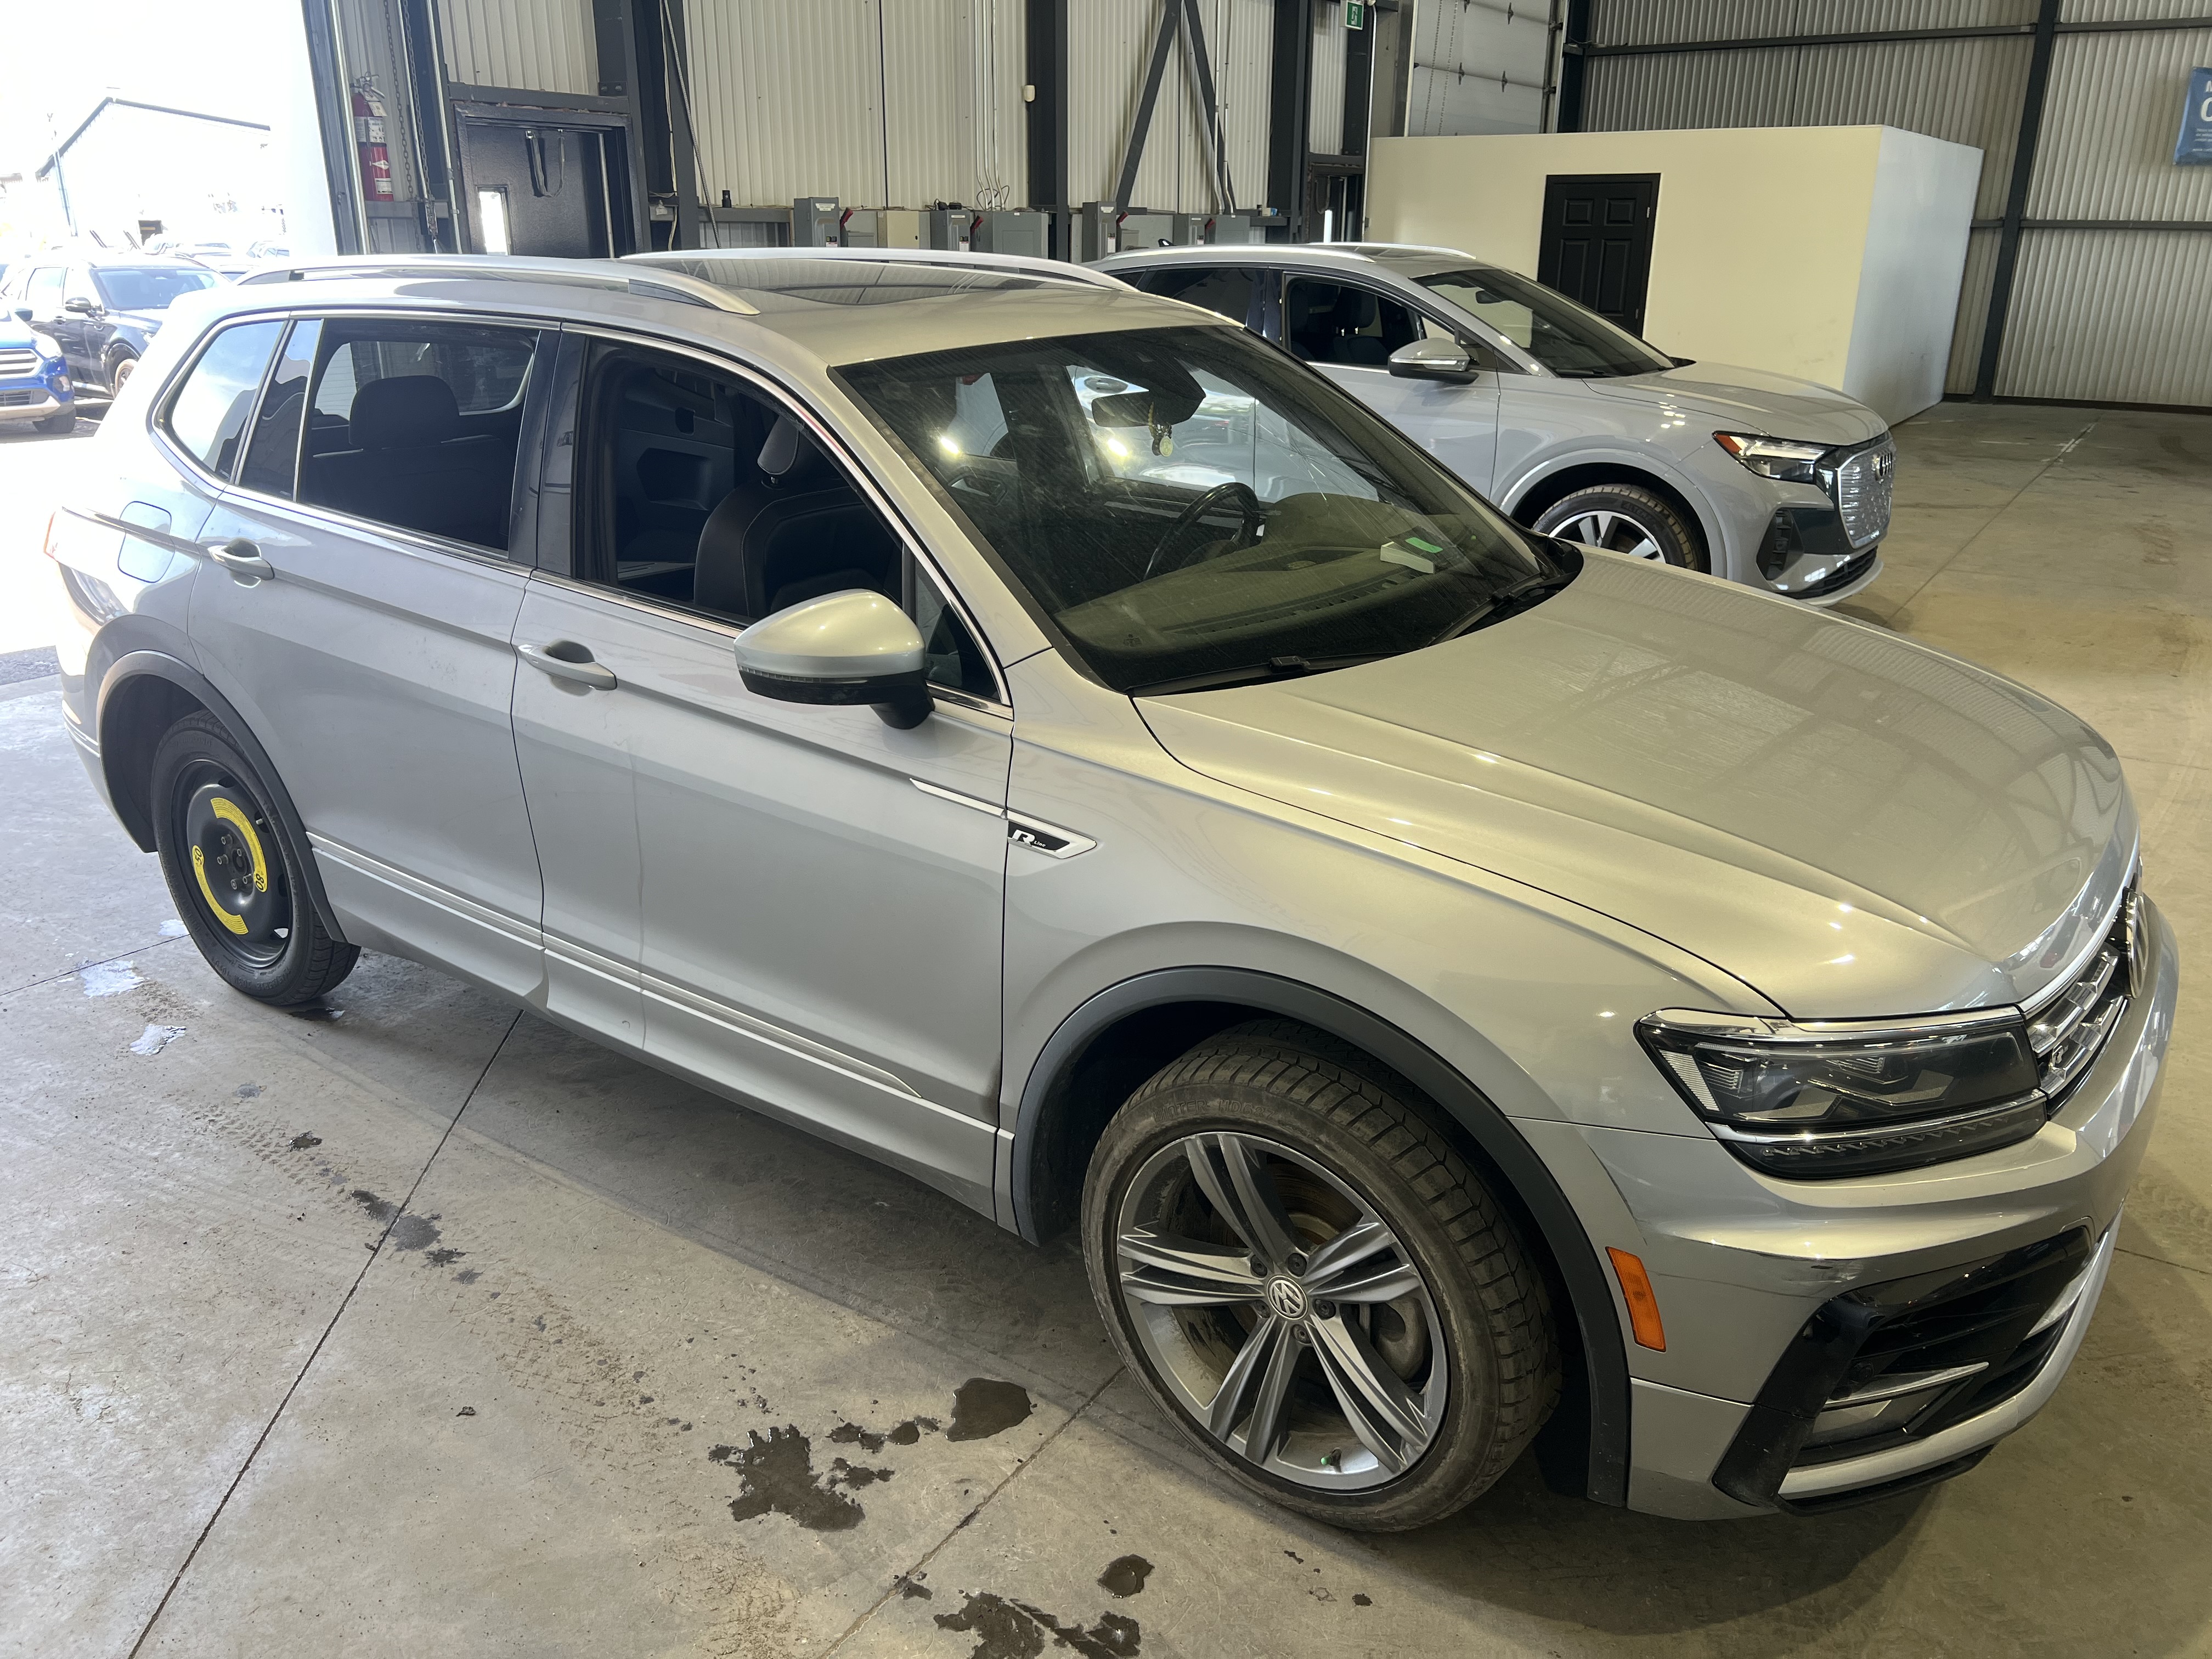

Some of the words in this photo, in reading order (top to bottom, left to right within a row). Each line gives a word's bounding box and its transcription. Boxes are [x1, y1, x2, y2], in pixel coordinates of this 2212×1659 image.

[1012, 829, 1036, 847] R
[194, 848, 202, 865] 50
[255, 873, 264, 891] 80
[1152, 1099, 1208, 1123] WINTER
